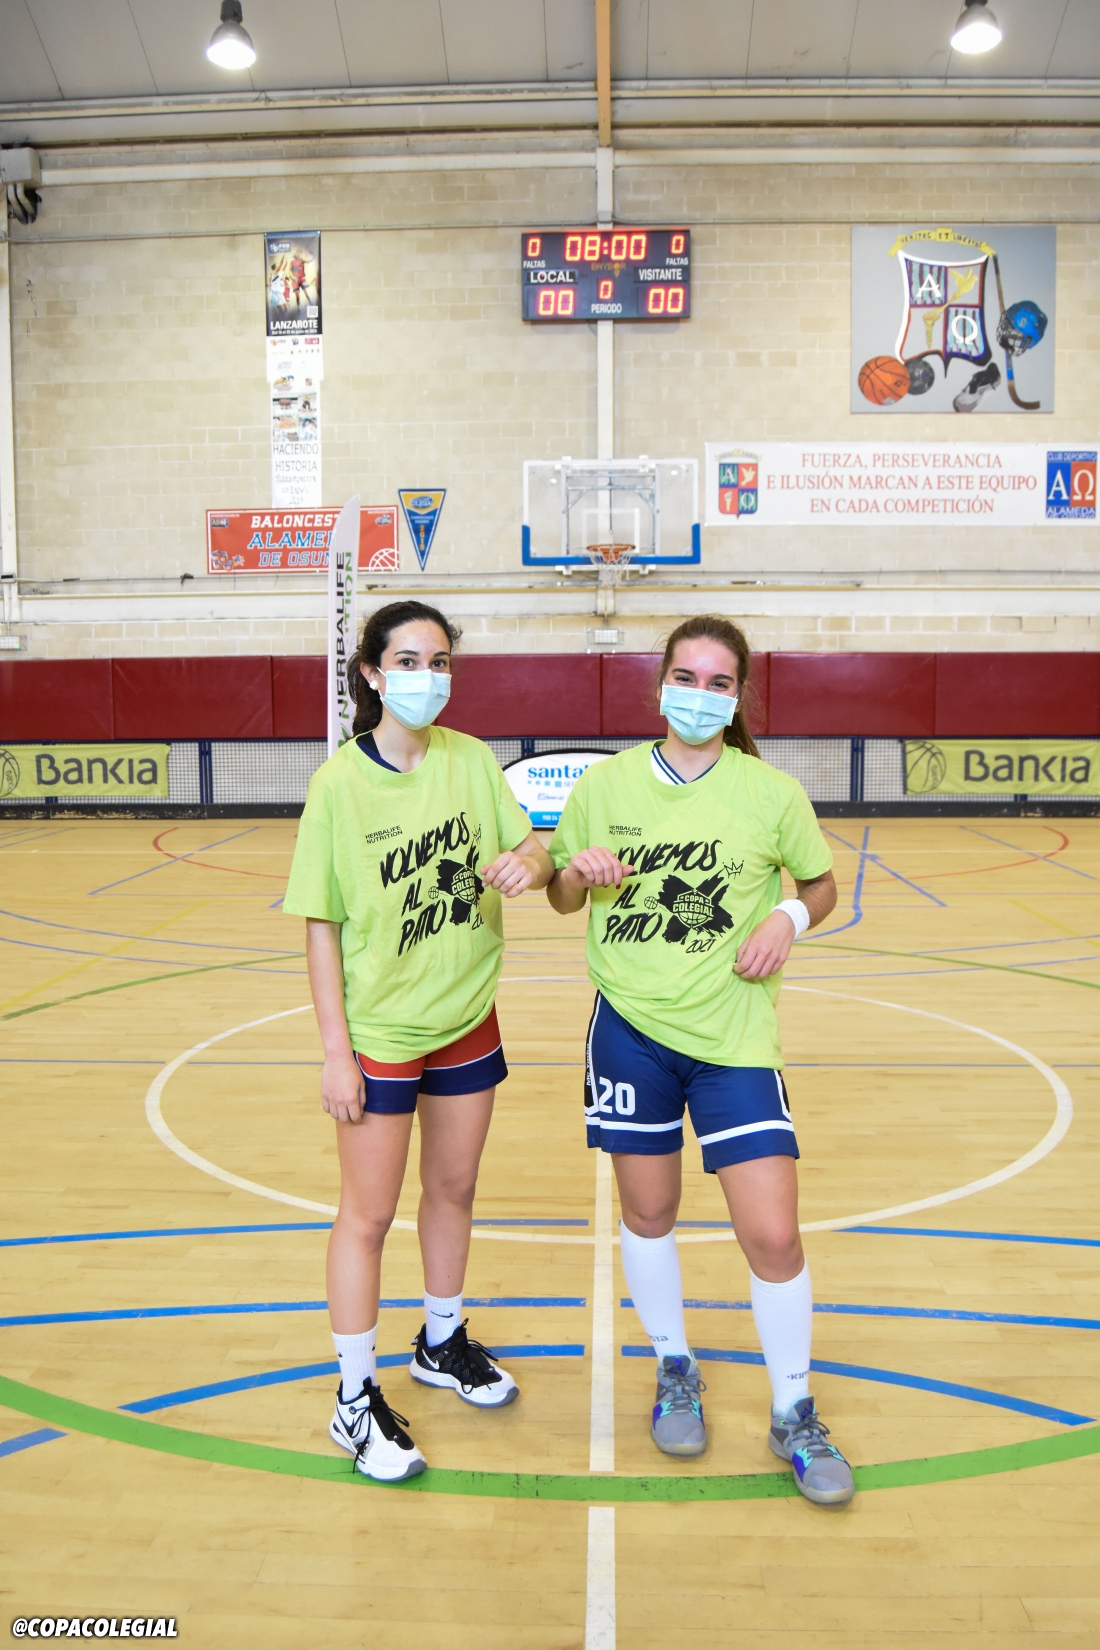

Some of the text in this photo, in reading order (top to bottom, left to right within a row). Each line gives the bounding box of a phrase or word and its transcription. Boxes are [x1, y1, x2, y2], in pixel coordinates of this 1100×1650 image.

[527, 237, 541, 257] 0
[565, 234, 647, 261] 08:00
[671, 235, 685, 254] 0
[523, 260, 546, 268] FALTAS
[666, 257, 689, 266] FALTAS
[530, 271, 574, 283] LOCAL
[638, 268, 683, 281] VISITANTE
[599, 280, 614, 300] 0
[916, 274, 942, 298] A
[538, 290, 575, 316] 00
[591, 303, 623, 314] PERIODO
[647, 288, 685, 314] 00
[270, 319, 318, 331] LANZAROTE
[272, 443, 319, 455] HACIENDO
[275, 460, 318, 472] HISTORIA
[801, 452, 1003, 470] FUERZA, PERSEVERANCIA
[766, 471, 1038, 491] E ILUSIÓN MARCAN A ESTE EQUIPO
[809, 495, 995, 513] EN CADA COMPETICIÓN
[251, 513, 340, 529] BALONCES
[258, 551, 282, 567] DE
[35, 753, 158, 786] Bankia
[964, 749, 1091, 784] Bankia
[365, 825, 402, 839] HERBALIFE
[609, 824, 643, 832] HERBALIFE
[366, 830, 403, 845] NUTRITION
[380, 811, 470, 889] VOLVEMOS
[401, 877, 423, 918] AL
[610, 882, 641, 910] AL
[684, 894, 705, 904] COPA
[672, 902, 714, 917] COLEGIAL
[685, 938, 717, 954] 2021
[598, 1076, 636, 1116] 20
